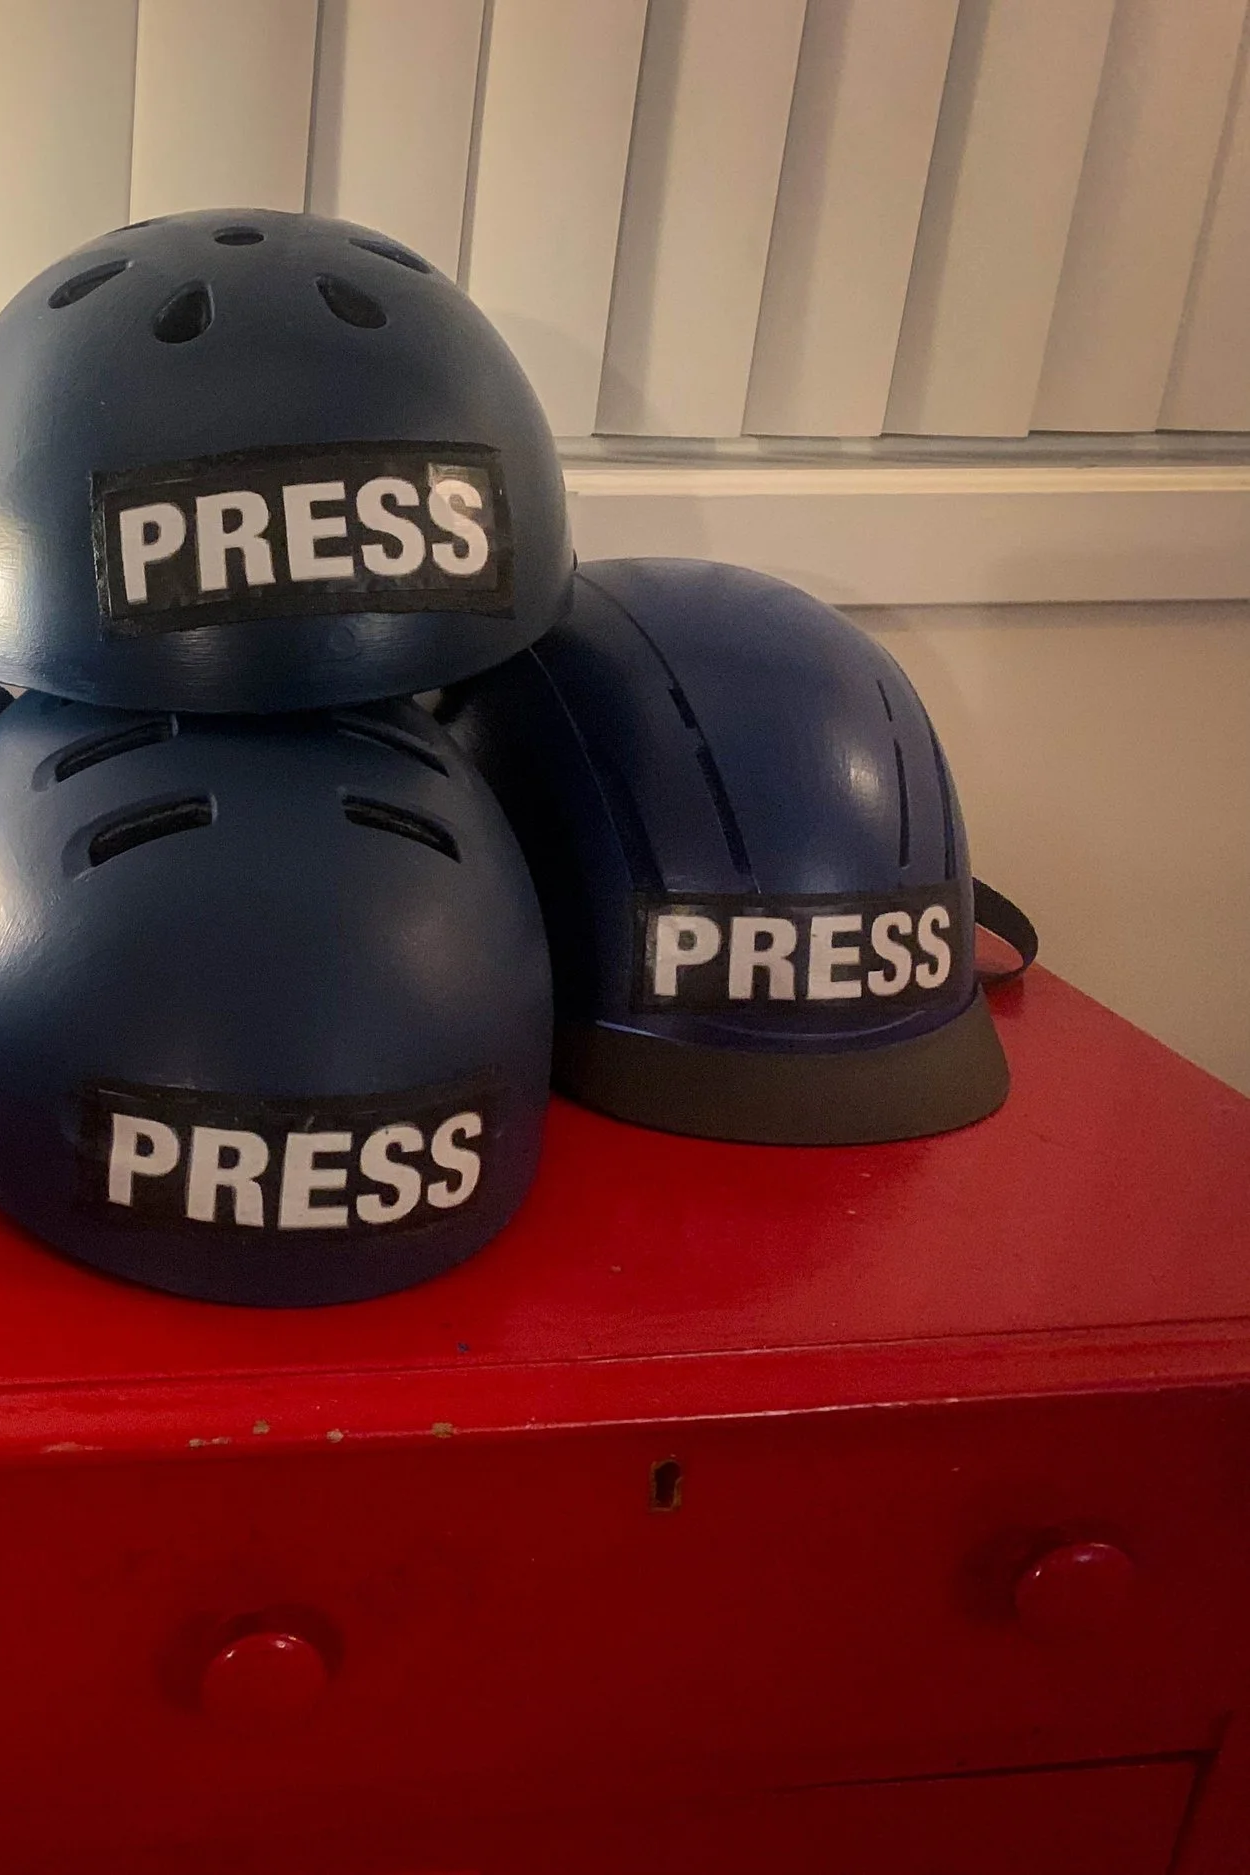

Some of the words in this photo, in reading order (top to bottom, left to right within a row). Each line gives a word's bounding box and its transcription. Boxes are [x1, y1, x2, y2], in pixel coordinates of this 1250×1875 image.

[118, 475, 491, 604] PRESS
[652, 904, 952, 1001] PRESS
[107, 1111, 483, 1230] PRESS
